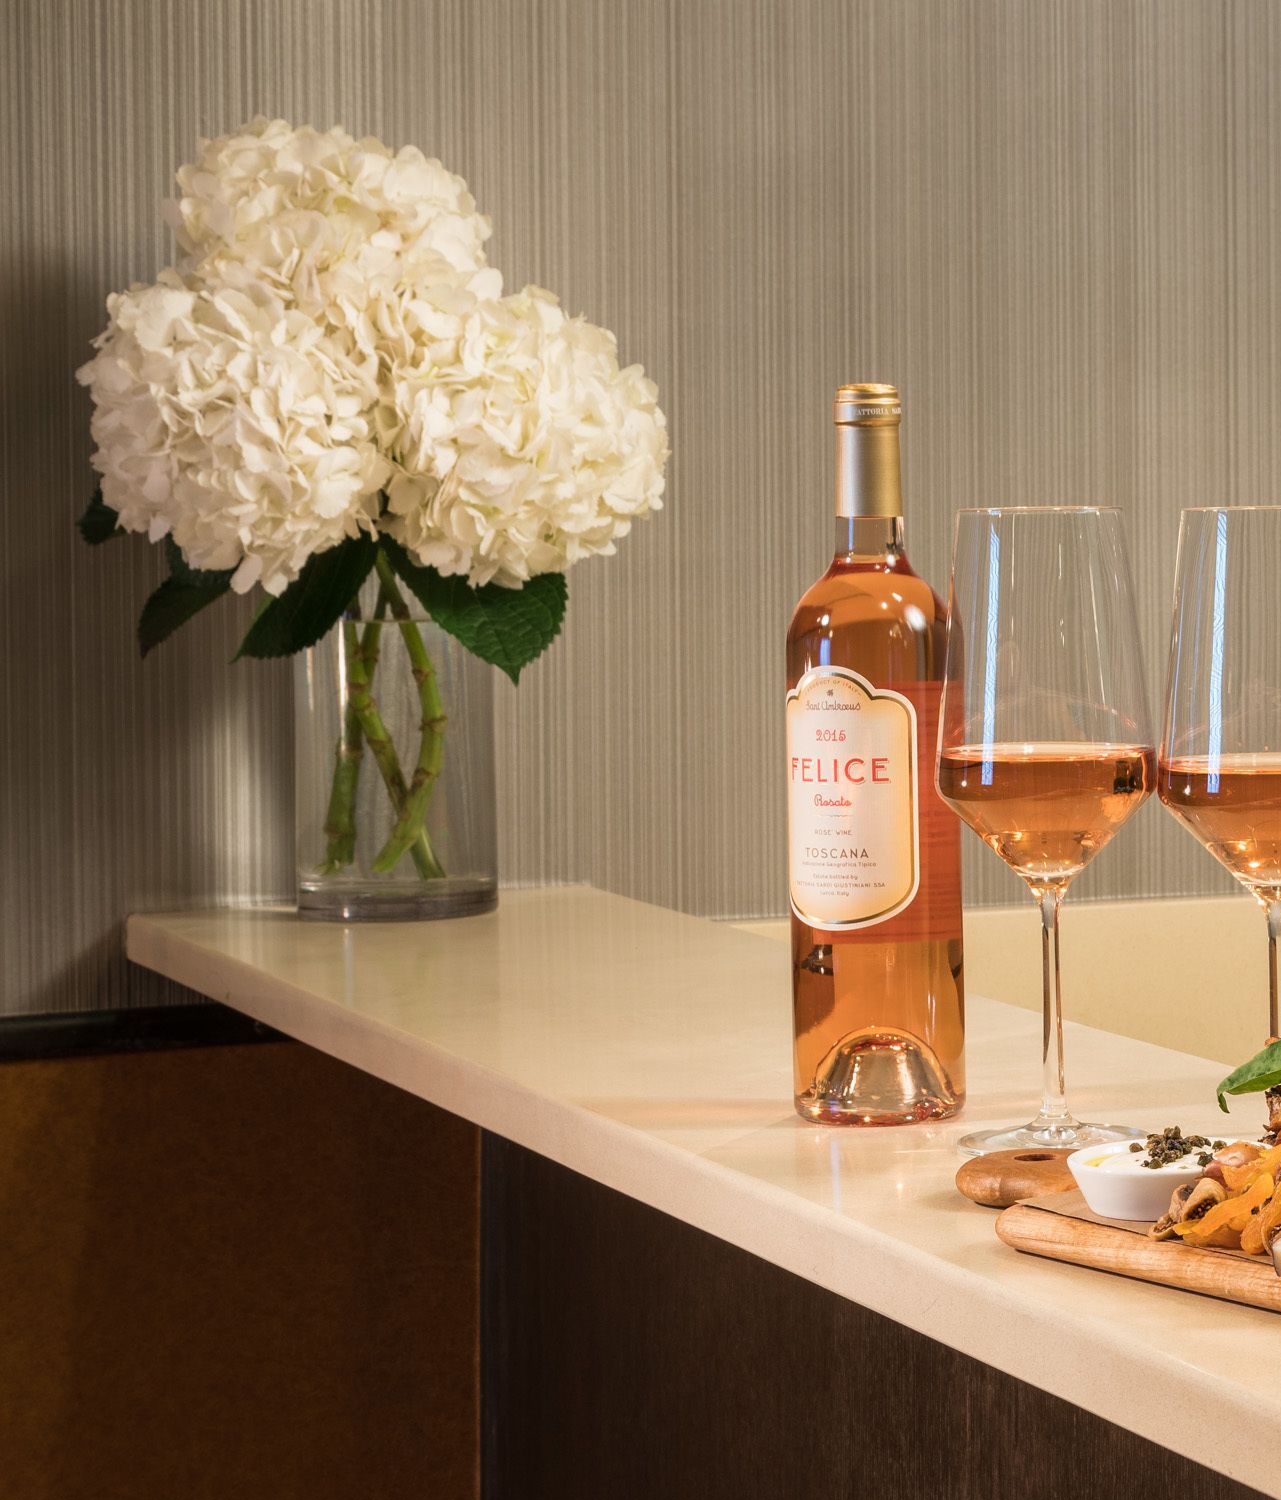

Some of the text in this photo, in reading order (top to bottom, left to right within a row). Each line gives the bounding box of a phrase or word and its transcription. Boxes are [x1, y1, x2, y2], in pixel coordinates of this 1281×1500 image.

[792, 757, 890, 784] FELICE
[814, 793, 852, 807] Rosato
[805, 847, 869, 859] TOSCANA
